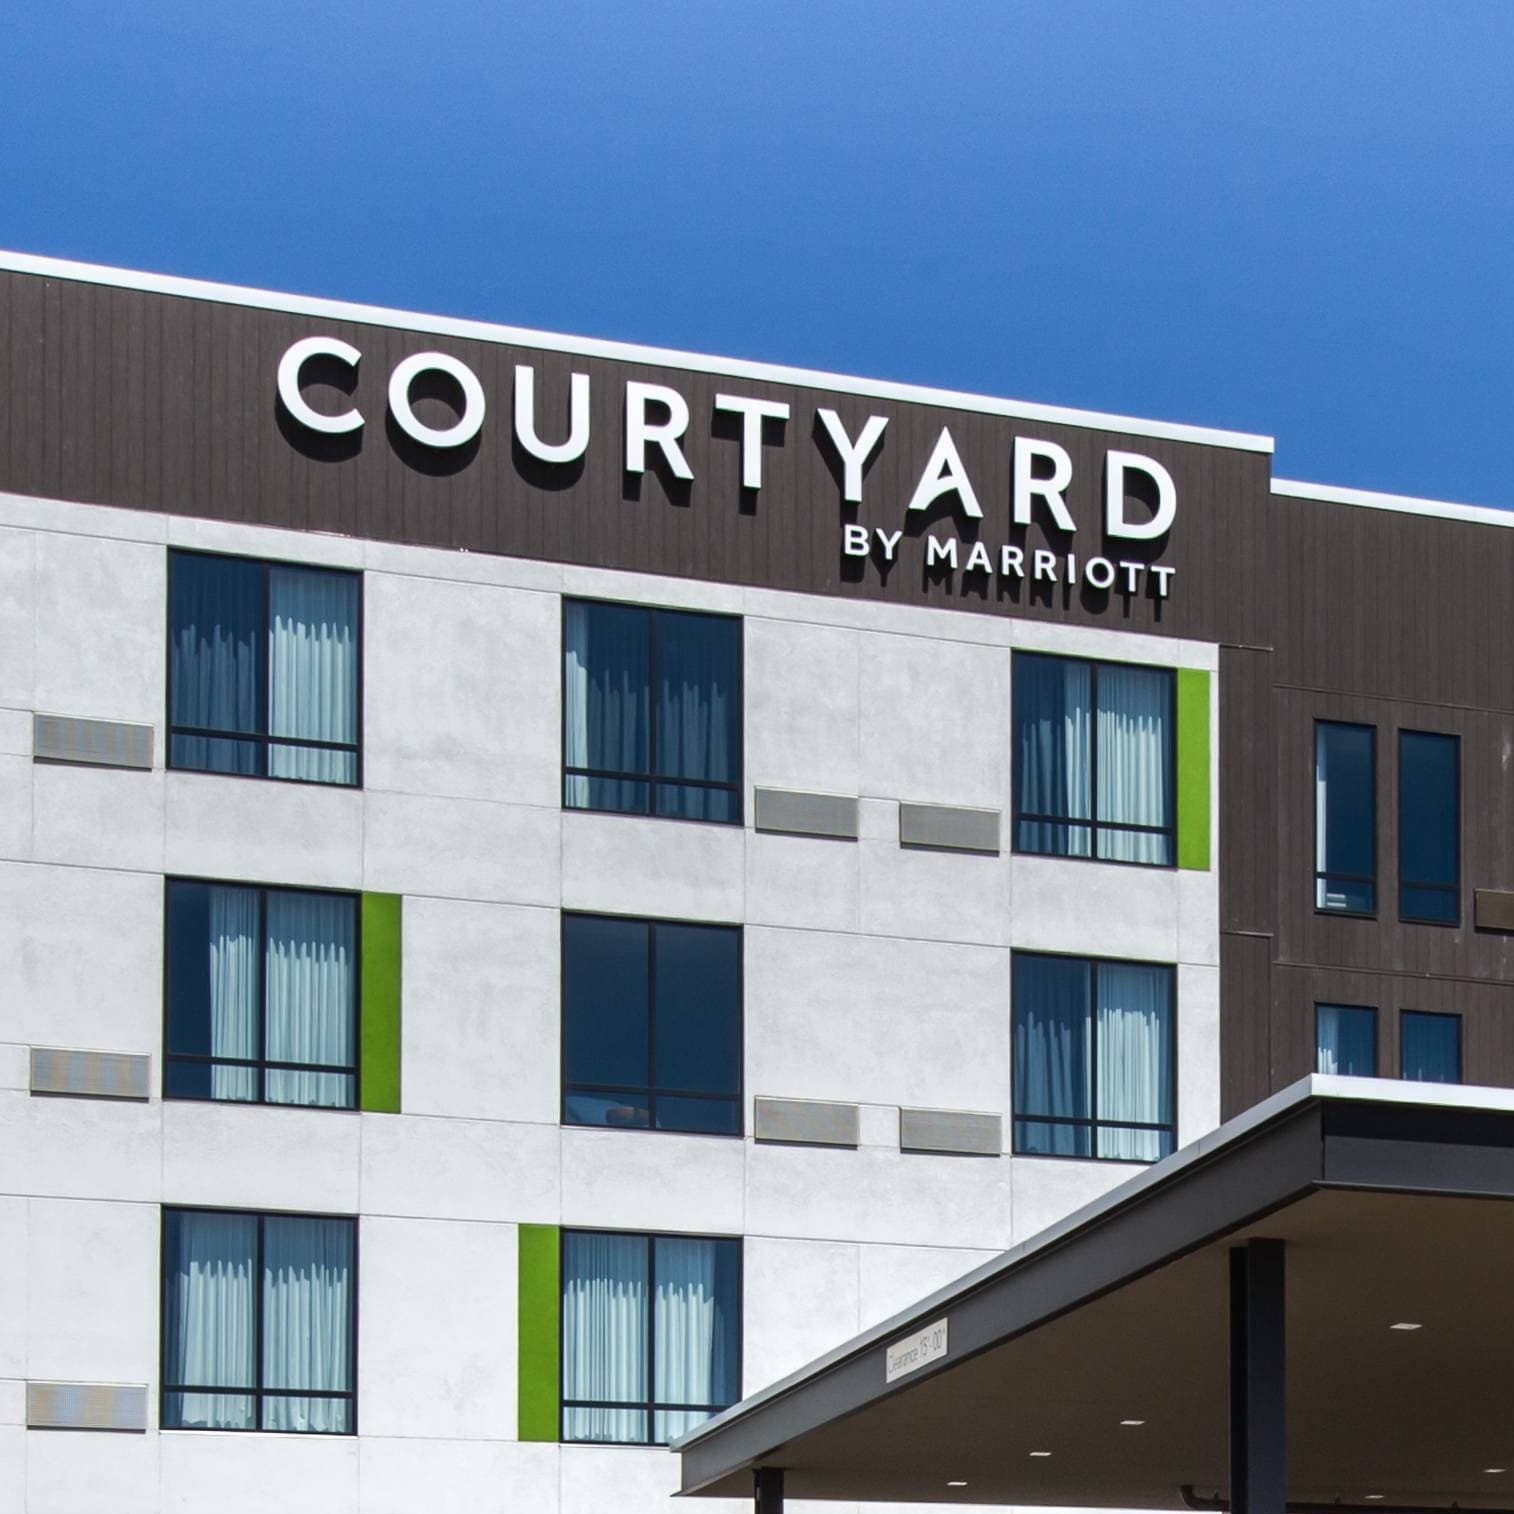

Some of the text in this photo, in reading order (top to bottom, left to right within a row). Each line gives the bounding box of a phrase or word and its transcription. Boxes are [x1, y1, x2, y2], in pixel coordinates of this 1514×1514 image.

[278, 335, 1178, 540] COURTYARD
[844, 523, 1177, 597] BY MARRIOTT
